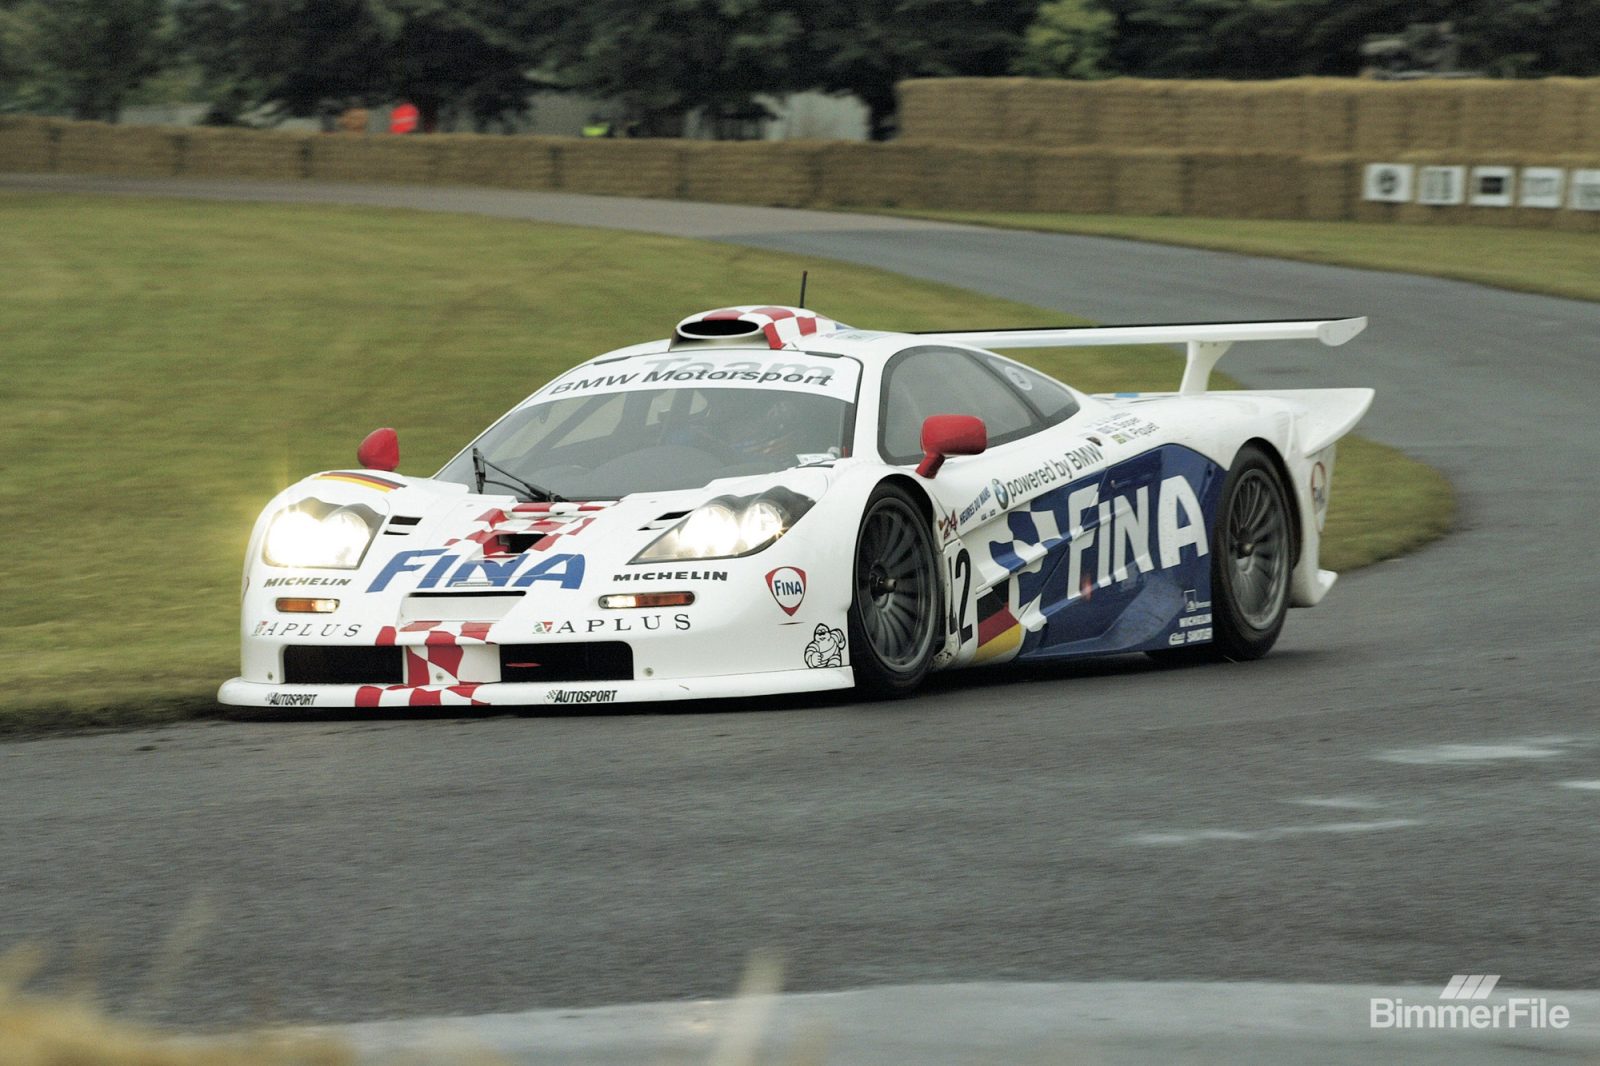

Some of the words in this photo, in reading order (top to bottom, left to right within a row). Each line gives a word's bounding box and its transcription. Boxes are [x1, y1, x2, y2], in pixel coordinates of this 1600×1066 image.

[550, 372, 640, 395] BMW
[641, 369, 833, 387] Motorsport
[1007, 459, 1057, 504] powered
[1055, 461, 1073, 480] by
[1064, 444, 1105, 471] BMW
[943, 509, 959, 540] 24
[1067, 475, 1209, 600] FINA
[365, 548, 586, 593] FINA
[612, 571, 729, 582] MICHELIN
[263, 577, 352, 588] MICHELIN
[773, 579, 803, 597] FINA
[261, 622, 363, 638] APLUS
[556, 613, 691, 634] APLUS
[268, 692, 318, 706] AUTOSPORT
[553, 689, 618, 704] AUTOSPORT
